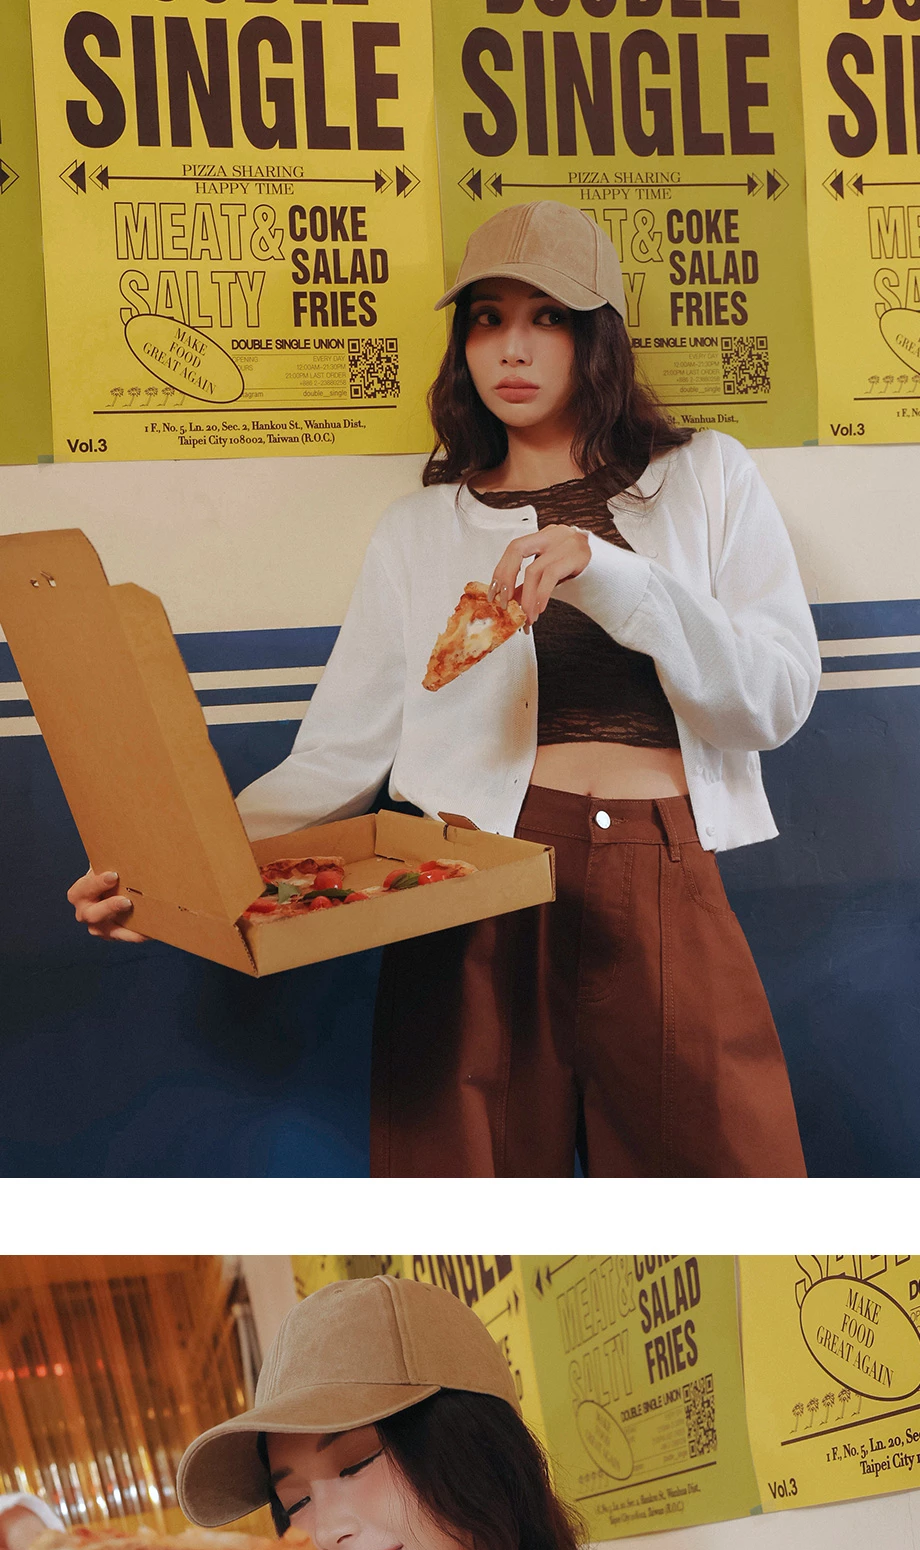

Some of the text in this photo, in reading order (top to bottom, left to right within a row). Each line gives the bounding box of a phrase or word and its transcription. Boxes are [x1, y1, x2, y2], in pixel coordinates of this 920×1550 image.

[63, 11, 405, 151] SINGLE
[461, 27, 775, 158] SINGLE
[182, 164, 304, 178] PIZZA SHARING
[195, 182, 295, 195] HAPPY TIME
[568, 171, 681, 184] PIZZA SHARING
[580, 188, 672, 200] HAPPY TIME
[114, 202, 285, 261] MEAT&
[288, 205, 367, 242] COKE
[666, 208, 740, 244] COKE
[291, 248, 389, 285] SALAD
[669, 250, 759, 286] SALAD
[120, 269, 266, 328] SALTY
[294, 291, 377, 327] FRIES
[671, 291, 749, 327] FRIES
[170, 341, 202, 369] FOOD
[175, 328, 208, 356] MAKE
[232, 339, 345, 350] DOUBLE SINGLE UNION
[143, 341, 216, 395] GREAT AGAIN
[163, 423, 178, 432] No.
[189, 423, 204, 432] Ln.
[206, 424, 220, 432] 20,
[222, 421, 240, 431] Sec.
[252, 421, 287, 430] Hankou
[289, 421, 303, 431] St.,
[304, 420, 341, 429] Wanhua
[343, 420, 366, 429] Dist.,
[178, 433, 335, 448] Taipei City 108002, Taiwan (R.O.C.)
[830, 423, 865, 436] Vol.3
[67, 439, 108, 453] Vol.3
[639, 1257, 700, 1333] SALAD
[845, 1288, 881, 1325] MAKE
[841, 1313, 875, 1349] FOOD
[644, 1319, 698, 1384] FRIES
[816, 1326, 894, 1388] GREAT AGAIN
[860, 1447, 914, 1477] Taipei City
[768, 1478, 798, 1499] Vol.3
